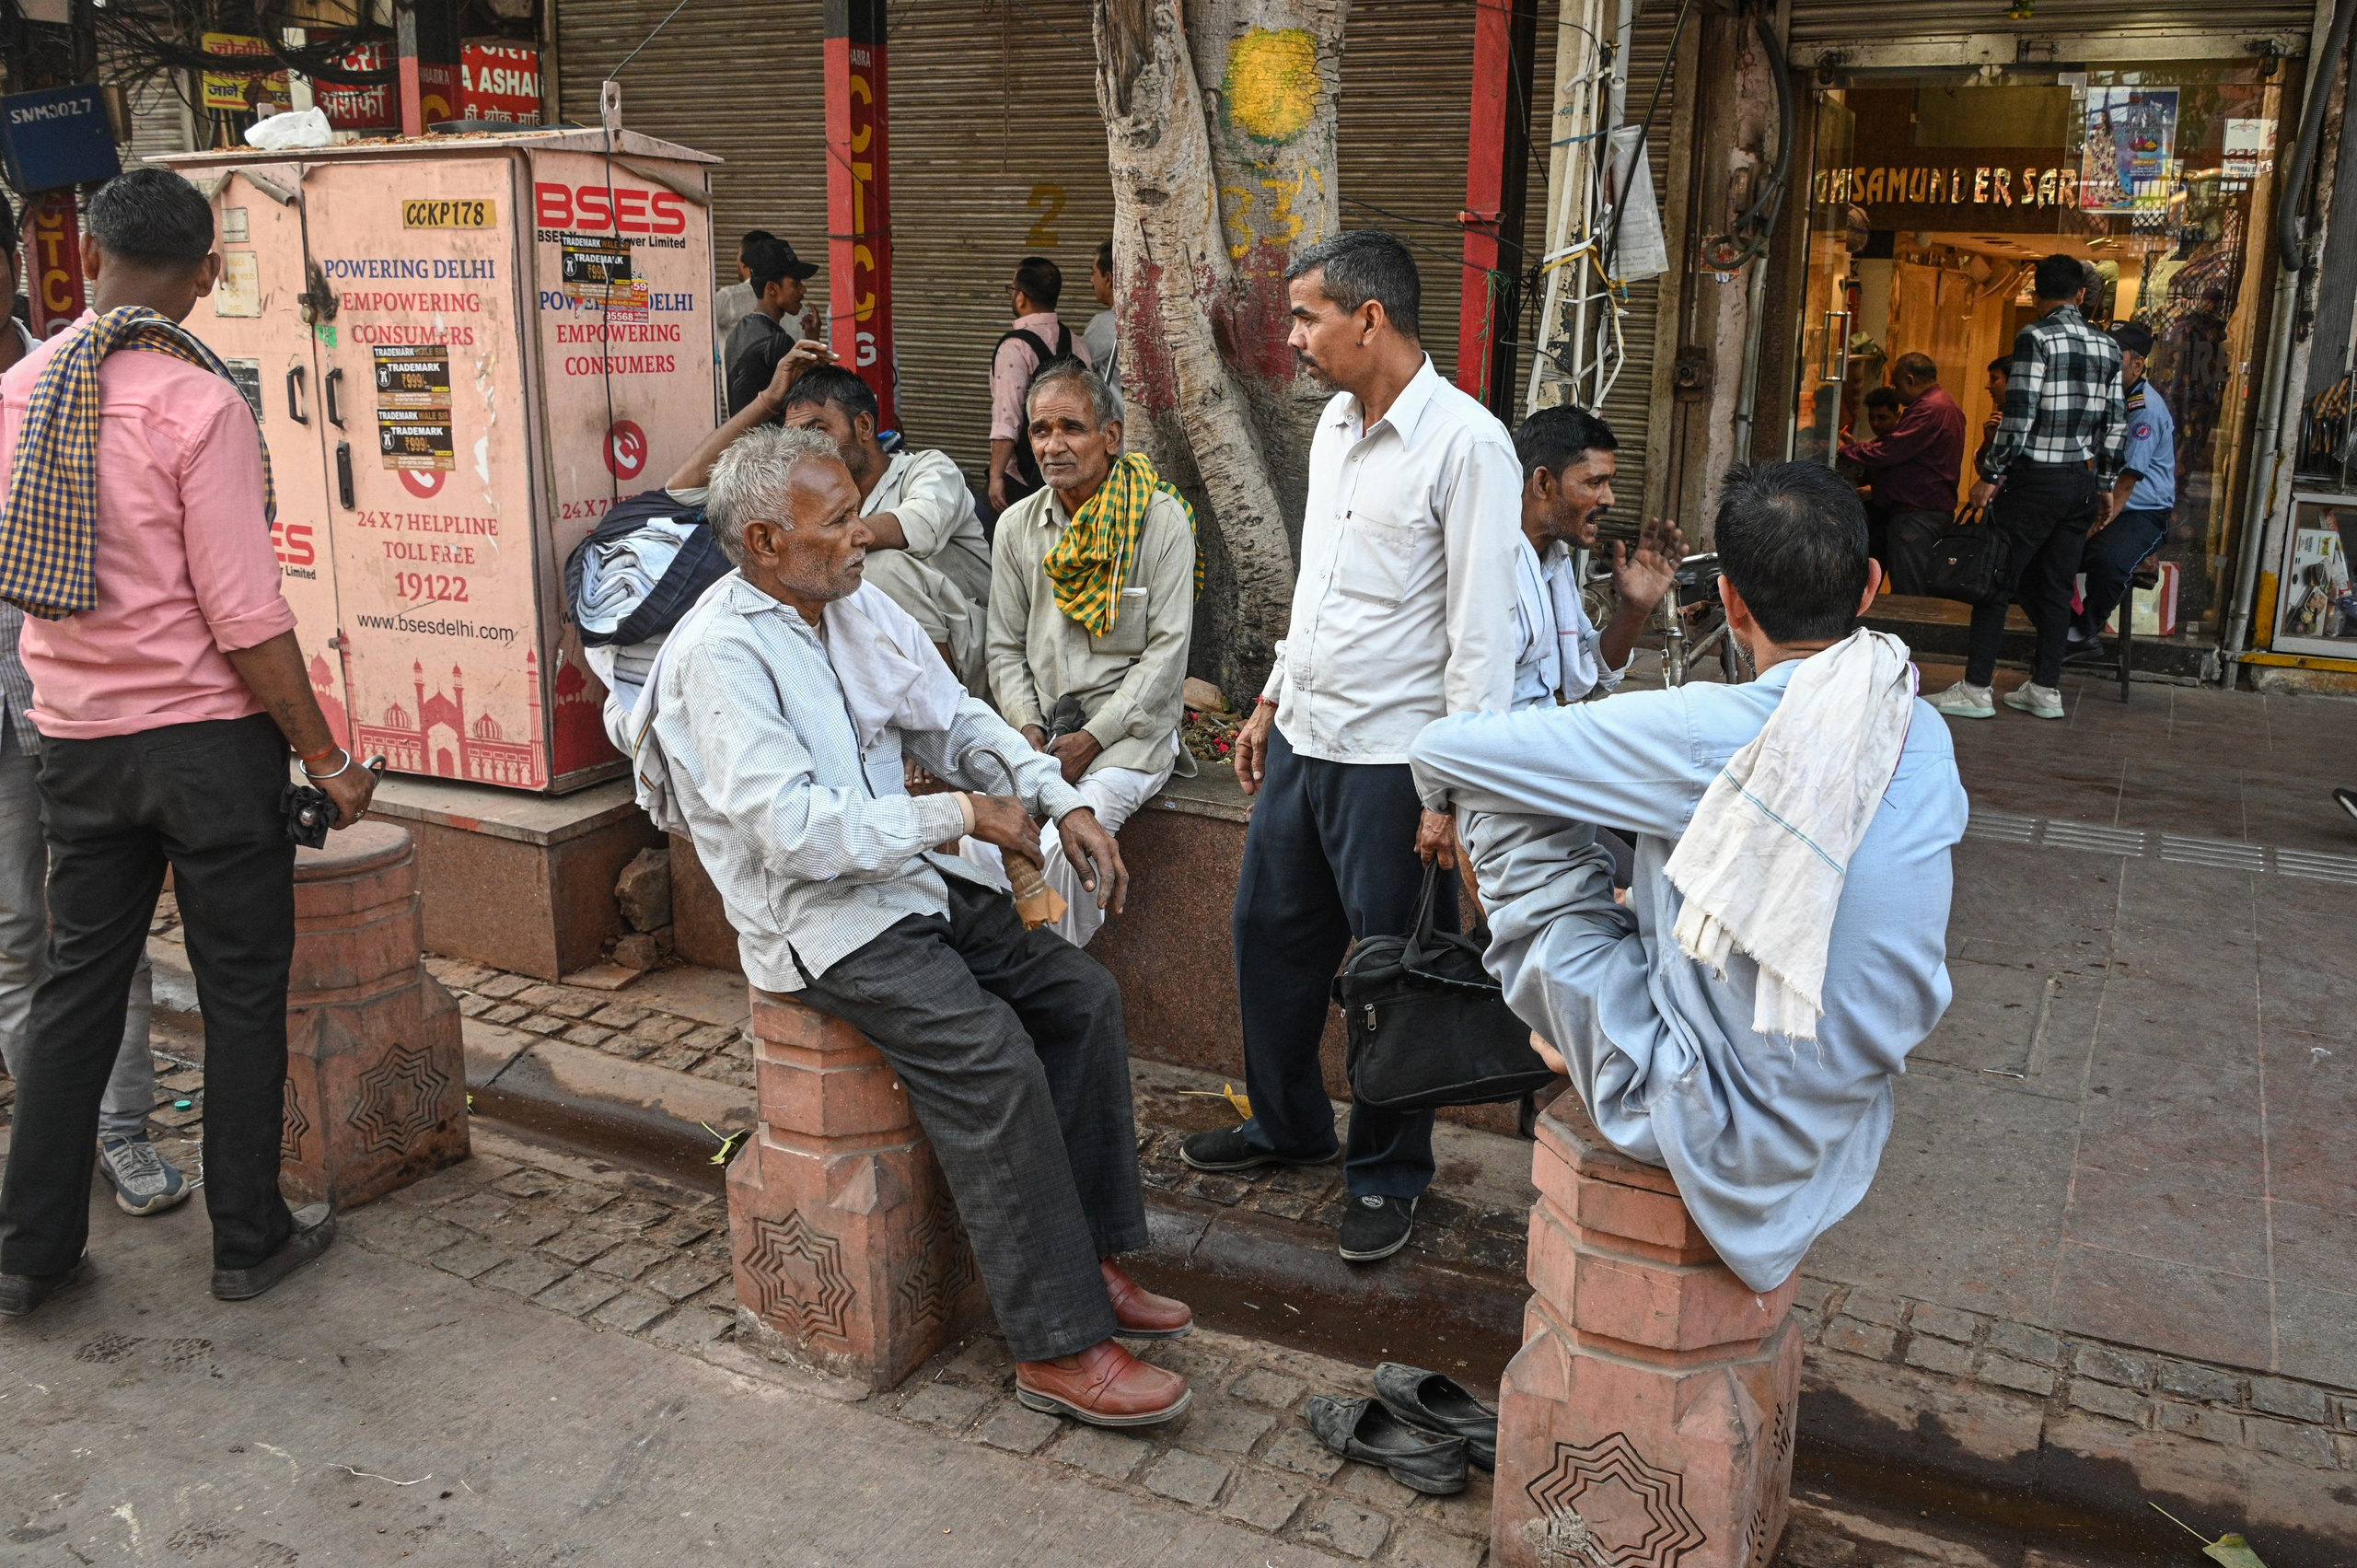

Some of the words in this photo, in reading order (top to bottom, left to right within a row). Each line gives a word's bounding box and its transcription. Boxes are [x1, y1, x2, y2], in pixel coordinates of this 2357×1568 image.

[407, 202, 485, 226] CCKP178
[535, 182, 686, 235] BSES
[1026, 184, 1066, 247] 2
[562, 237, 601, 249] TRADEMARK
[648, 236, 686, 250] Limited
[324, 260, 429, 279] POWERING
[433, 260, 496, 279] DELHI
[342, 292, 480, 313] EMPOWERING
[351, 324, 475, 346] CONSUMERS
[556, 324, 681, 343] EMPOWERING
[375, 347, 415, 357] TRADEMARK
[387, 363, 441, 372] TRADEMARK
[565, 354, 676, 376] CONSUMERS
[378, 411, 419, 421] TRADEMARK
[437, 412, 449, 421] SIR
[389, 426, 444, 436] TRADEMARK
[563, 501, 582, 520] 24
[585, 499, 598, 517] X
[598, 499, 609, 517] 7
[357, 511, 377, 528] 24
[378, 511, 392, 528] X
[394, 514, 403, 531] 7
[406, 513, 499, 537] HELPLINE
[383, 540, 427, 561] TOLL
[430, 544, 476, 564] FREE
[285, 564, 317, 580] Limited
[394, 571, 469, 603] 19122
[356, 613, 515, 642] www.bsesdelhi.com
